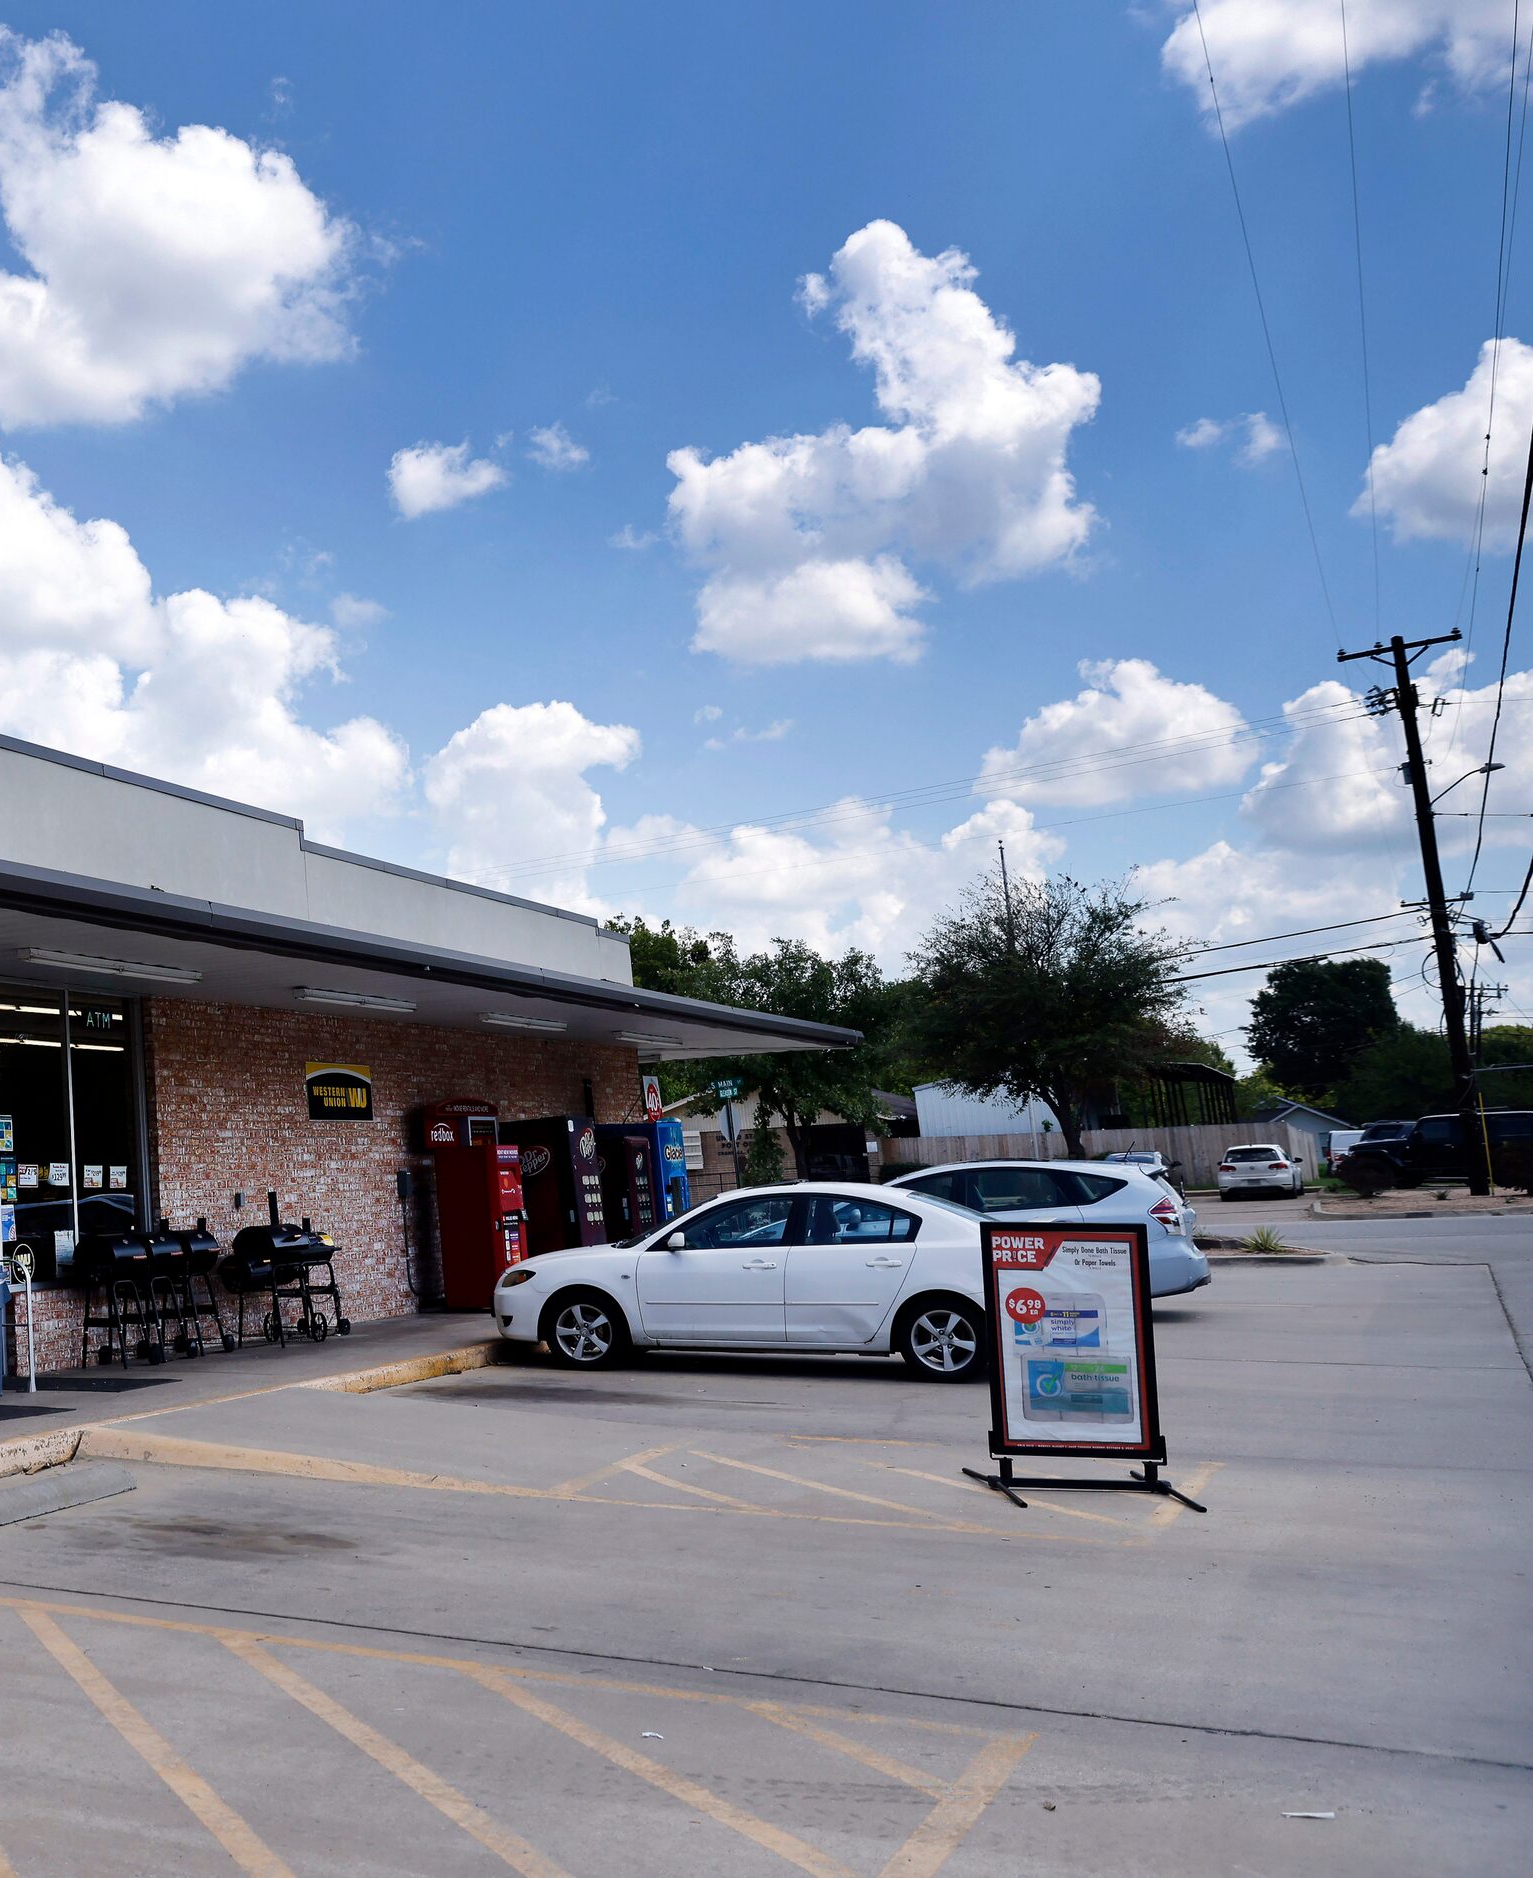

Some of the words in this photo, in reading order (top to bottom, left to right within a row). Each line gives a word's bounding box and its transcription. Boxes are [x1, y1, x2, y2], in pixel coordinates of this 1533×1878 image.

[87, 1010, 110, 1029] ATM
[718, 1080, 733, 1088] MAIN
[312, 1086, 345, 1096] WESTERN
[346, 1087, 367, 1108] WU
[324, 1097, 346, 1107] UNION
[431, 1127, 454, 1141] redbox
[524, 1150, 537, 1162] Dr
[665, 1146, 683, 1160] Glacie
[991, 1236, 1044, 1250] POWER
[1062, 1246, 1079, 1255] Simply
[1080, 1246, 1094, 1254] Done
[1110, 1247, 1127, 1255] Tissue
[1082, 1259, 1097, 1267] Paper
